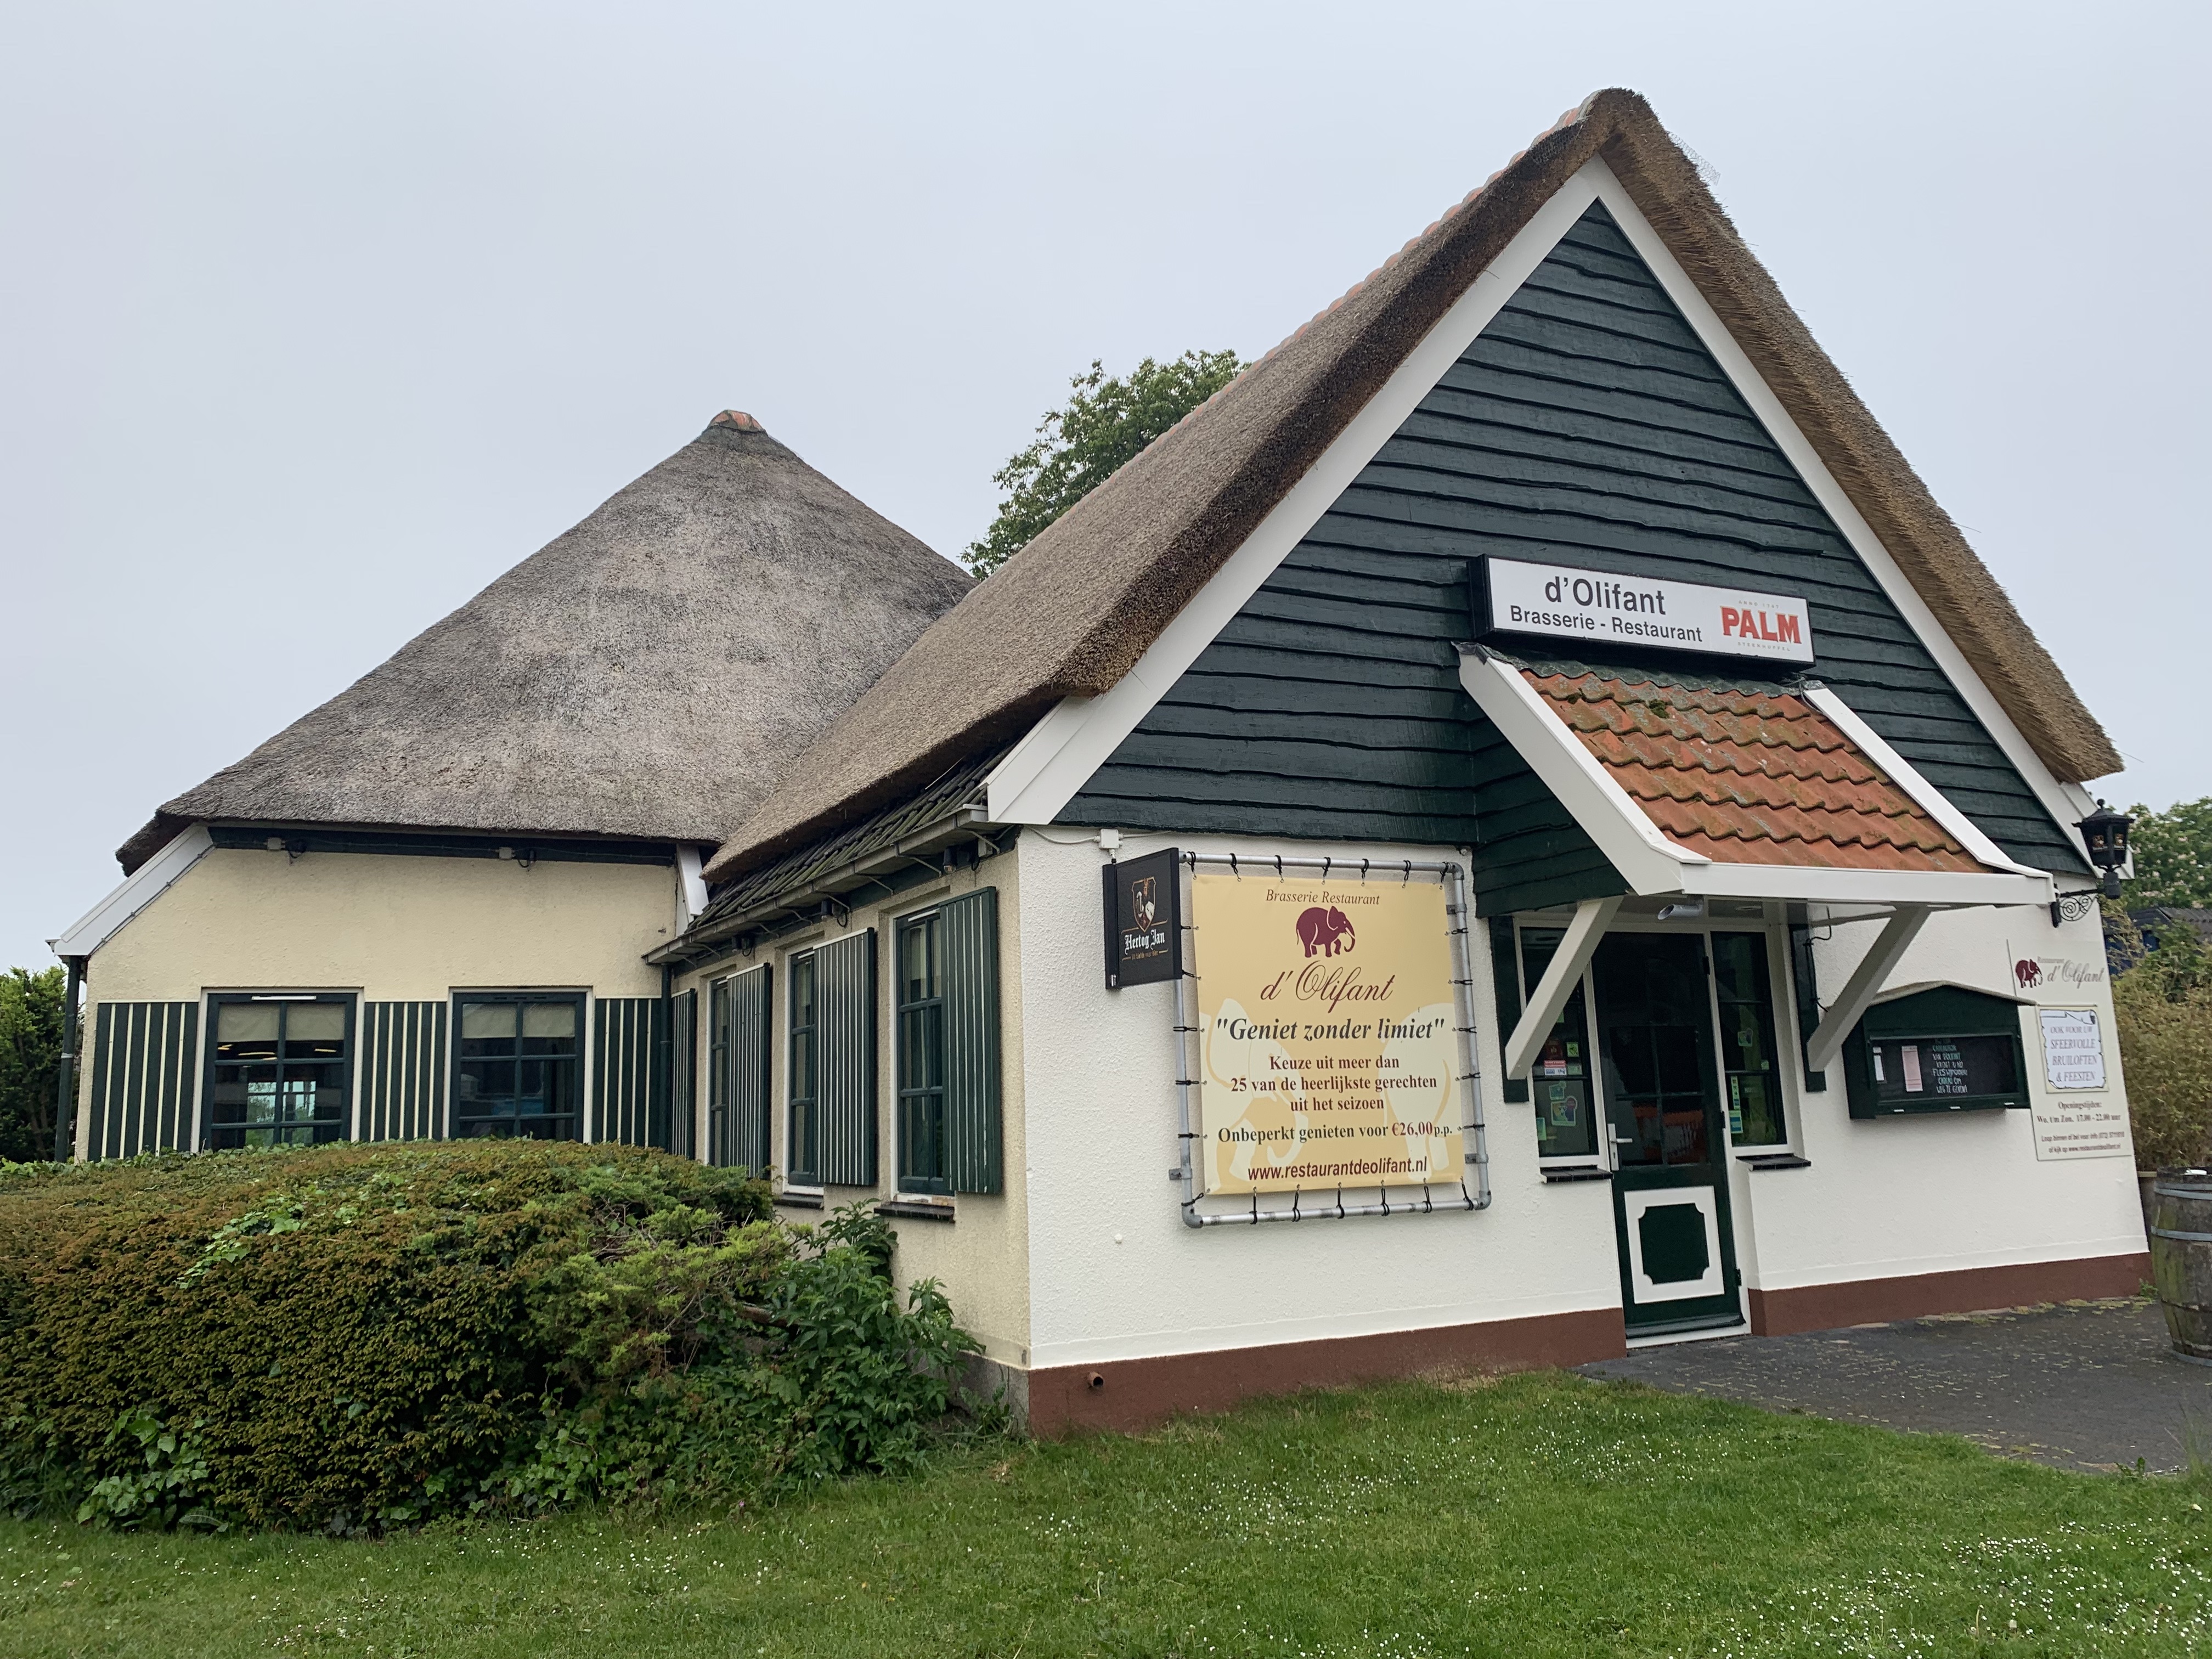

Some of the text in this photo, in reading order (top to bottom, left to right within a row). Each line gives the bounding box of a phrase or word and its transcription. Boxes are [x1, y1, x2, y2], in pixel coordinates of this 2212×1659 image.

[1510, 605, 1595, 630] Brasserie
[1612, 617, 1703, 642] Restaurant
[1719, 605, 1802, 645] PALM
[1265, 889, 1380, 905] Brasserie Restaurant
[1124, 929, 1165, 955] Hertog Jan
[1217, 1018, 1444, 1041] "Geniet zonder limiet"
[2051, 1039, 2096, 1049] SFEERVOLLE
[1269, 1055, 1400, 1070] Keuze uit meer dan
[2052, 1054, 2097, 1065] BRUILOFTEN
[1231, 1075, 1437, 1093] 25 van de heerlijkste gerechten
[2064, 1071, 2096, 1082] FEESTEN
[1290, 1096, 1384, 1112] uit het seizoen
[1218, 1125, 1295, 1146] Onbeperkt
[1299, 1125, 1355, 1144] genieten
[1359, 1125, 1389, 1137] voor
[1248, 1156, 1428, 1181] www.restaurantdeolifant.nl
